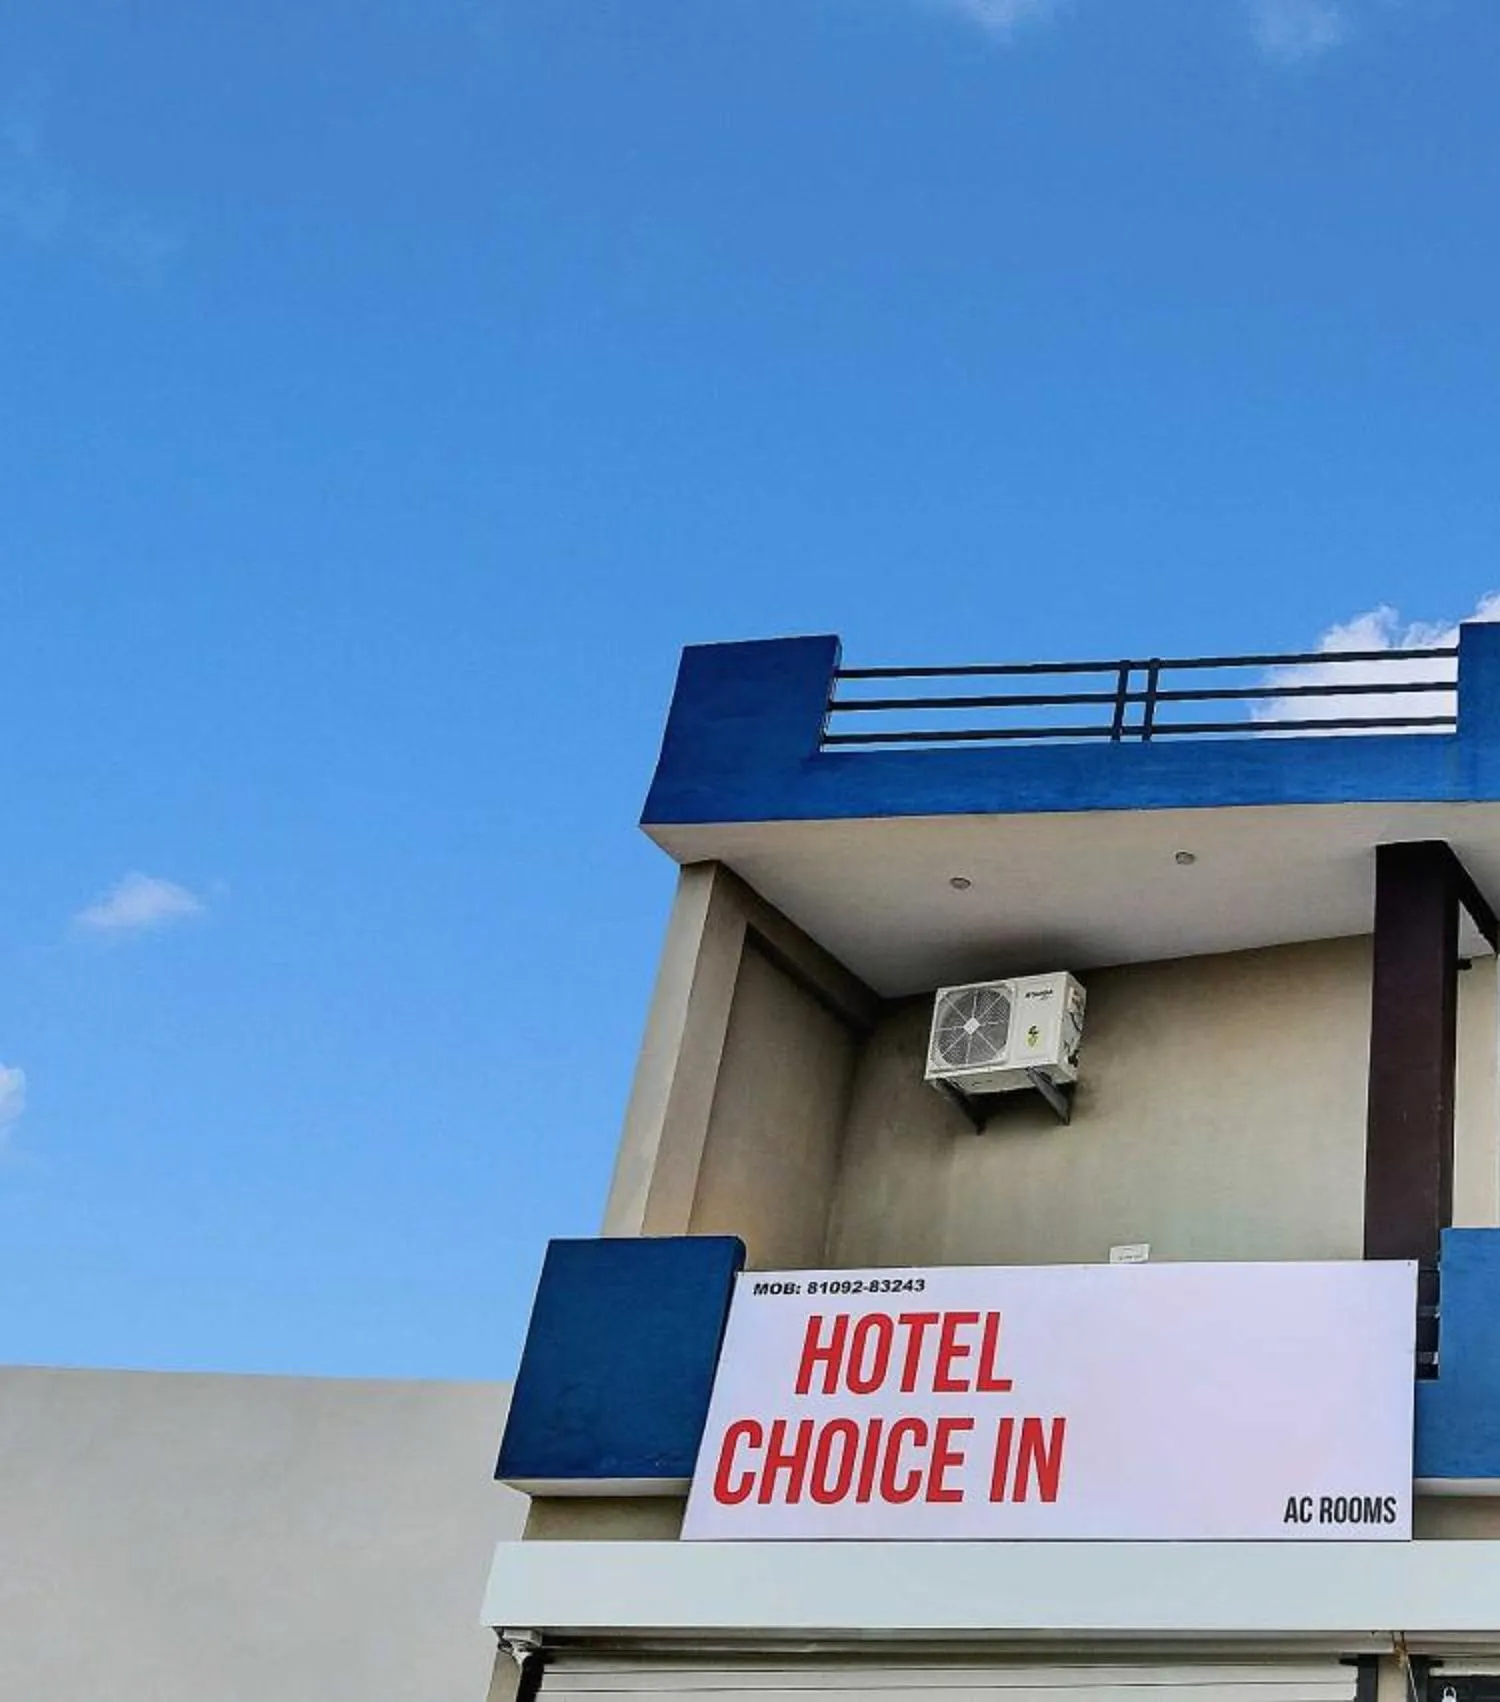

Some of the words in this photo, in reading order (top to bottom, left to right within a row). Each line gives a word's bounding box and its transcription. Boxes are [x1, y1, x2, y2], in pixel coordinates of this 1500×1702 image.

[753, 1282, 801, 1295] MOB:
[807, 1279, 926, 1295] 81092-83243
[795, 1311, 1013, 1395] HOTEL
[713, 1417, 975, 1505] CHOICE
[990, 1416, 1066, 1504] IN
[1283, 1496, 1314, 1524] AC
[1319, 1496, 1397, 1525] ROOMS
